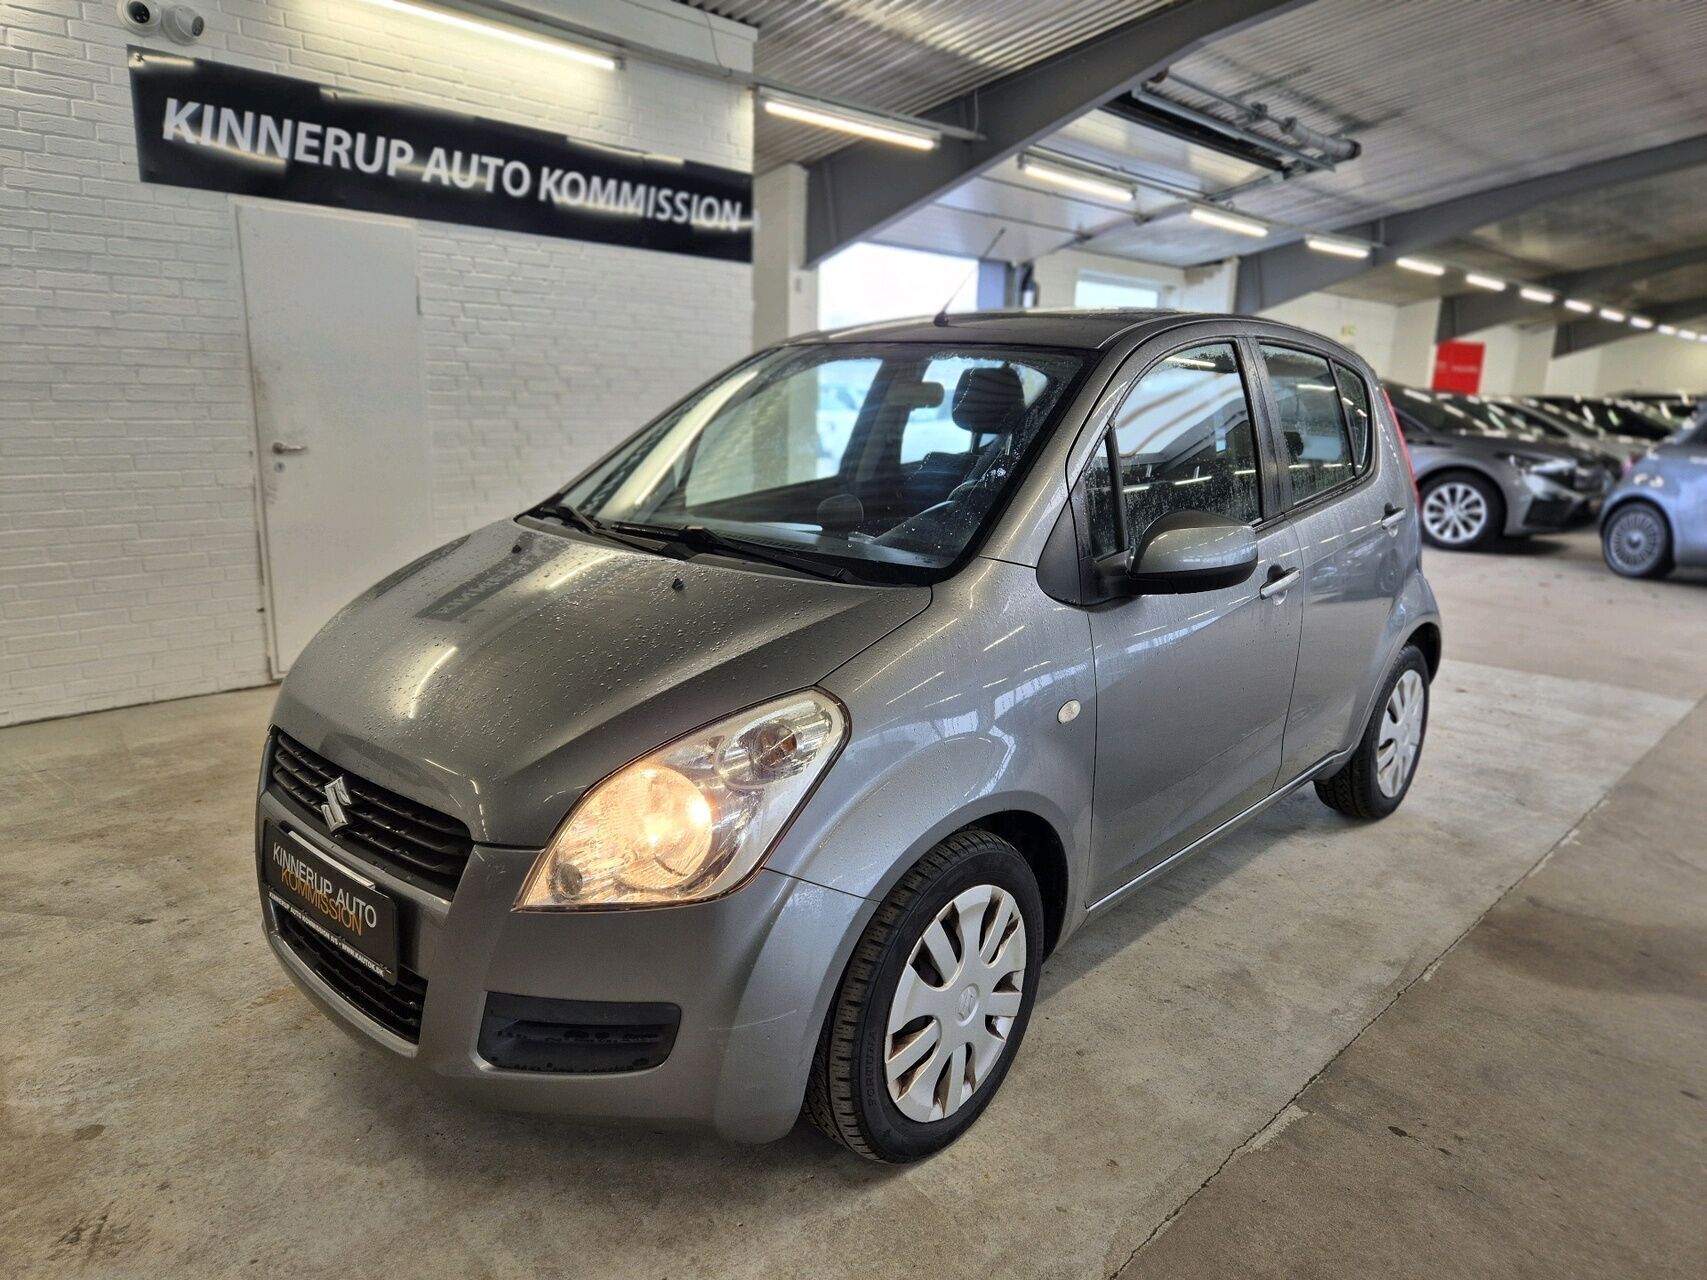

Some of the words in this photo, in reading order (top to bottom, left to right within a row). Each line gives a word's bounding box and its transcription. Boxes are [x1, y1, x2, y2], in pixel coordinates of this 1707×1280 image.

[162, 97, 414, 177] KINNERUP
[421, 146, 531, 198] AUTO
[538, 166, 742, 232] KOMMISSION
[273, 842, 333, 897] KINNERUP
[335, 887, 377, 928] AUTO
[281, 865, 361, 936] KOMMISSION
